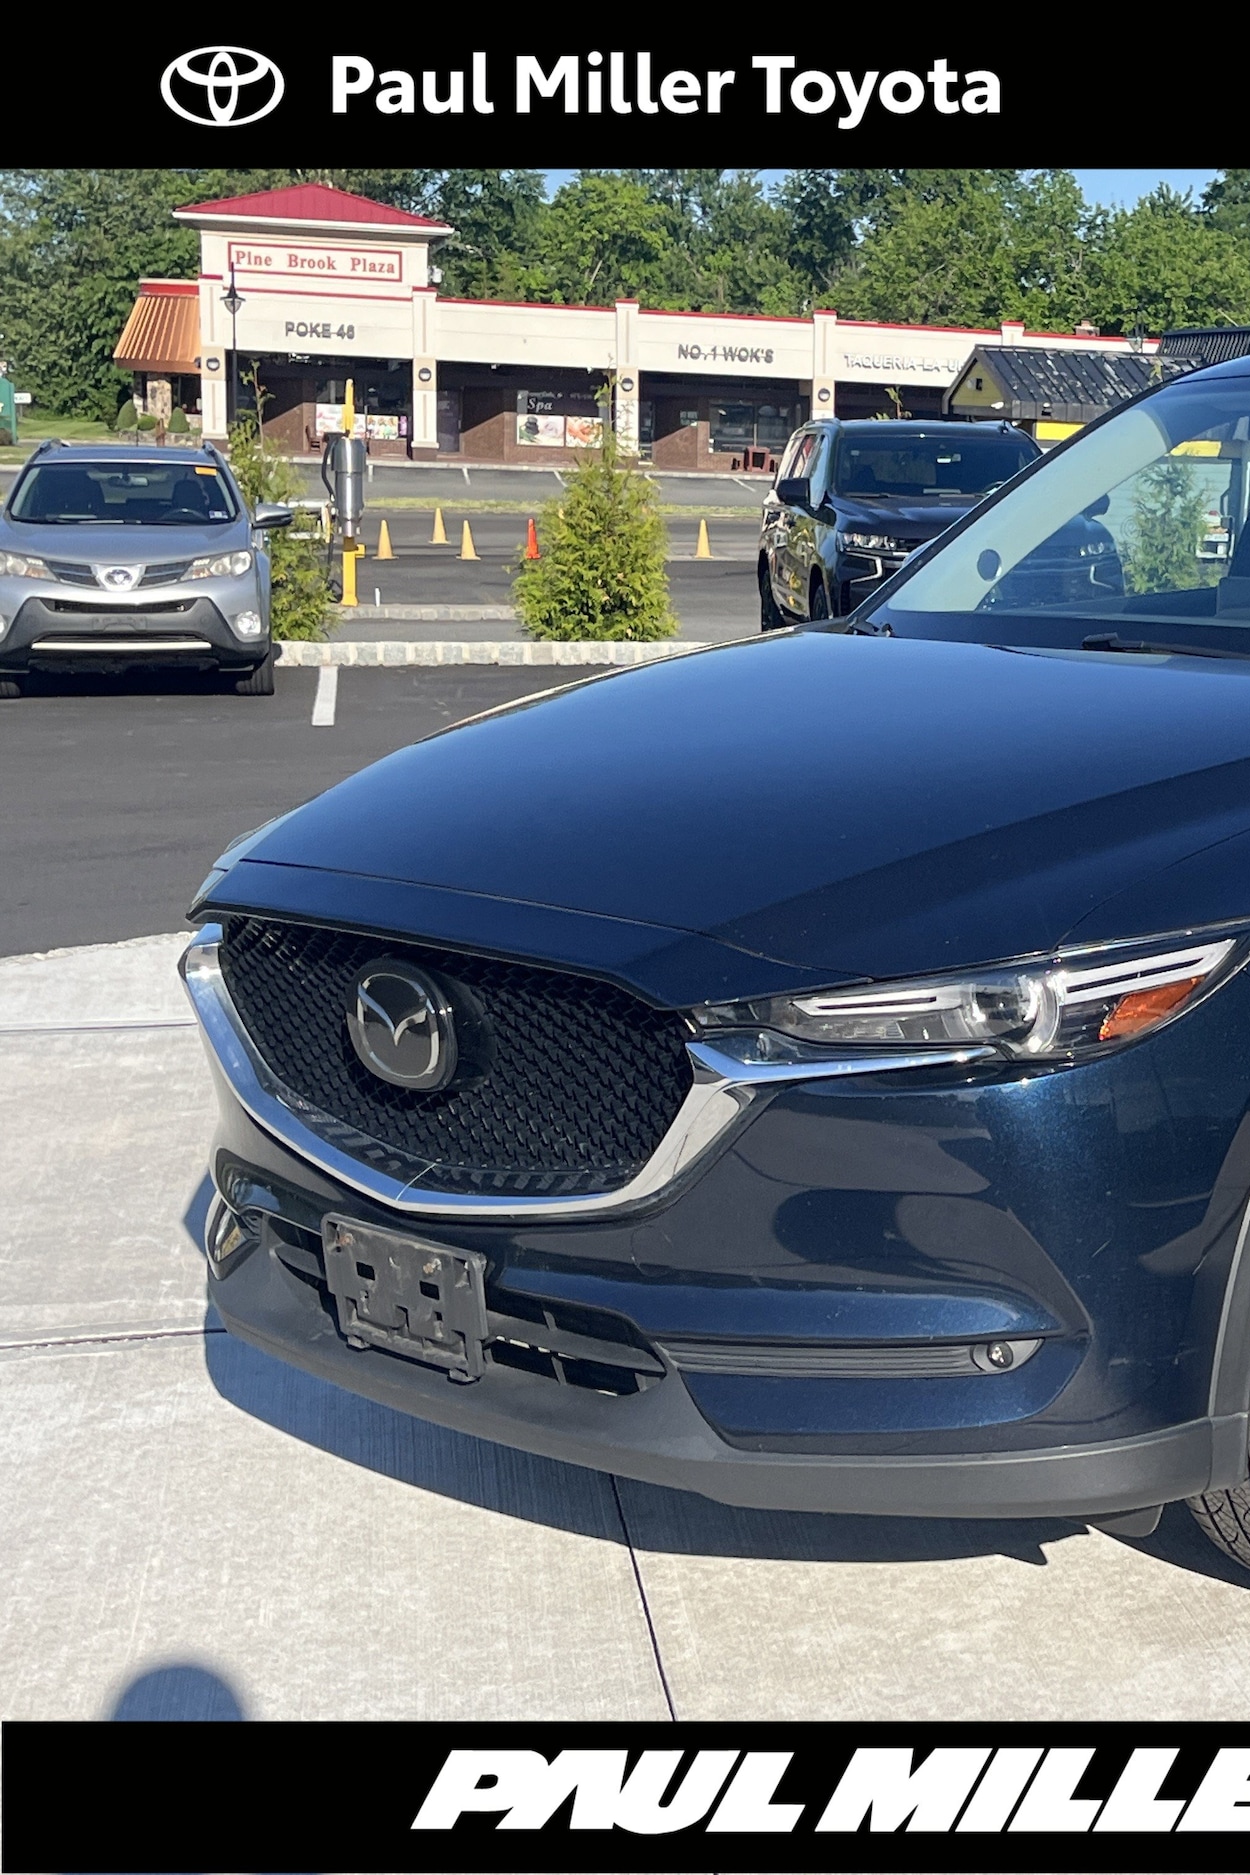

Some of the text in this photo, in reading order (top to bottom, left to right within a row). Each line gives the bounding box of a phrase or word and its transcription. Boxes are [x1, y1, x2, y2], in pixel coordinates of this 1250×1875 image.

[235, 250, 395, 274] Pine Brook Plaza
[285, 321, 331, 339] POKE
[722, 346, 774, 364] WOK'S
[843, 353, 916, 371] TAQUERIA
[527, 398, 553, 413] Spa
